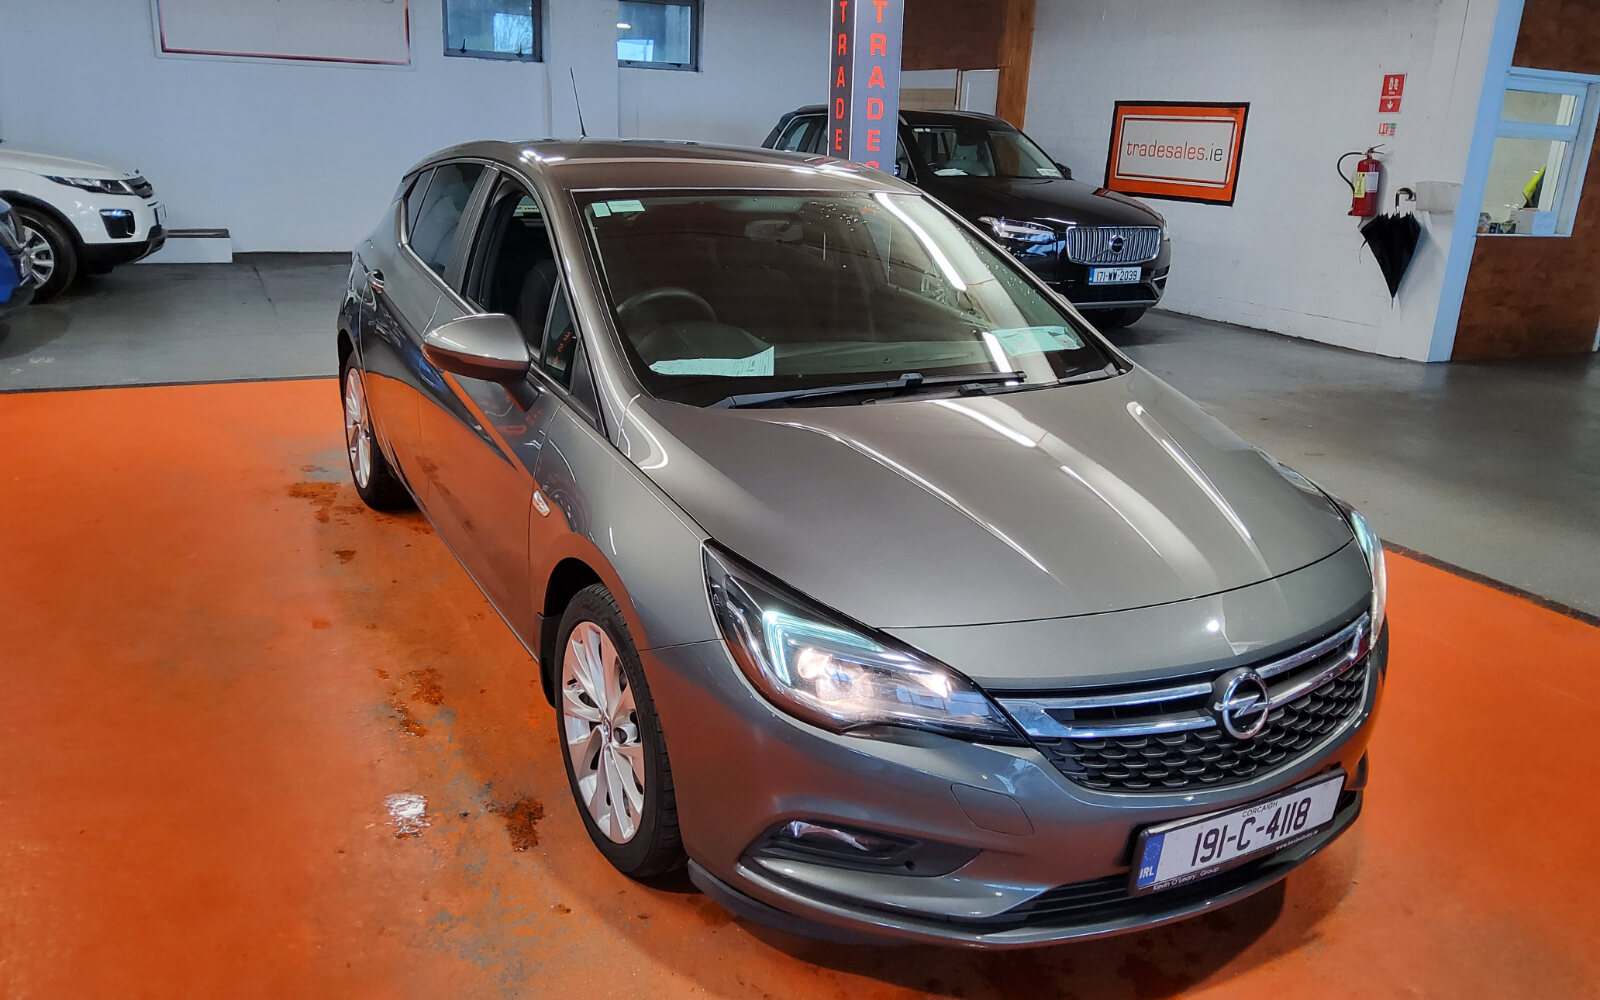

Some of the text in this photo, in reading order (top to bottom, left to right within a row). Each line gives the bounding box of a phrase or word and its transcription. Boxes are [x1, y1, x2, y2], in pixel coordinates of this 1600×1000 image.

[1126, 140, 1223, 162] tradesales.ie
[1242, 801, 1279, 818] CORCAIGH
[1190, 797, 1312, 867] 191-C-4118
[1139, 866, 1154, 879] IRL
